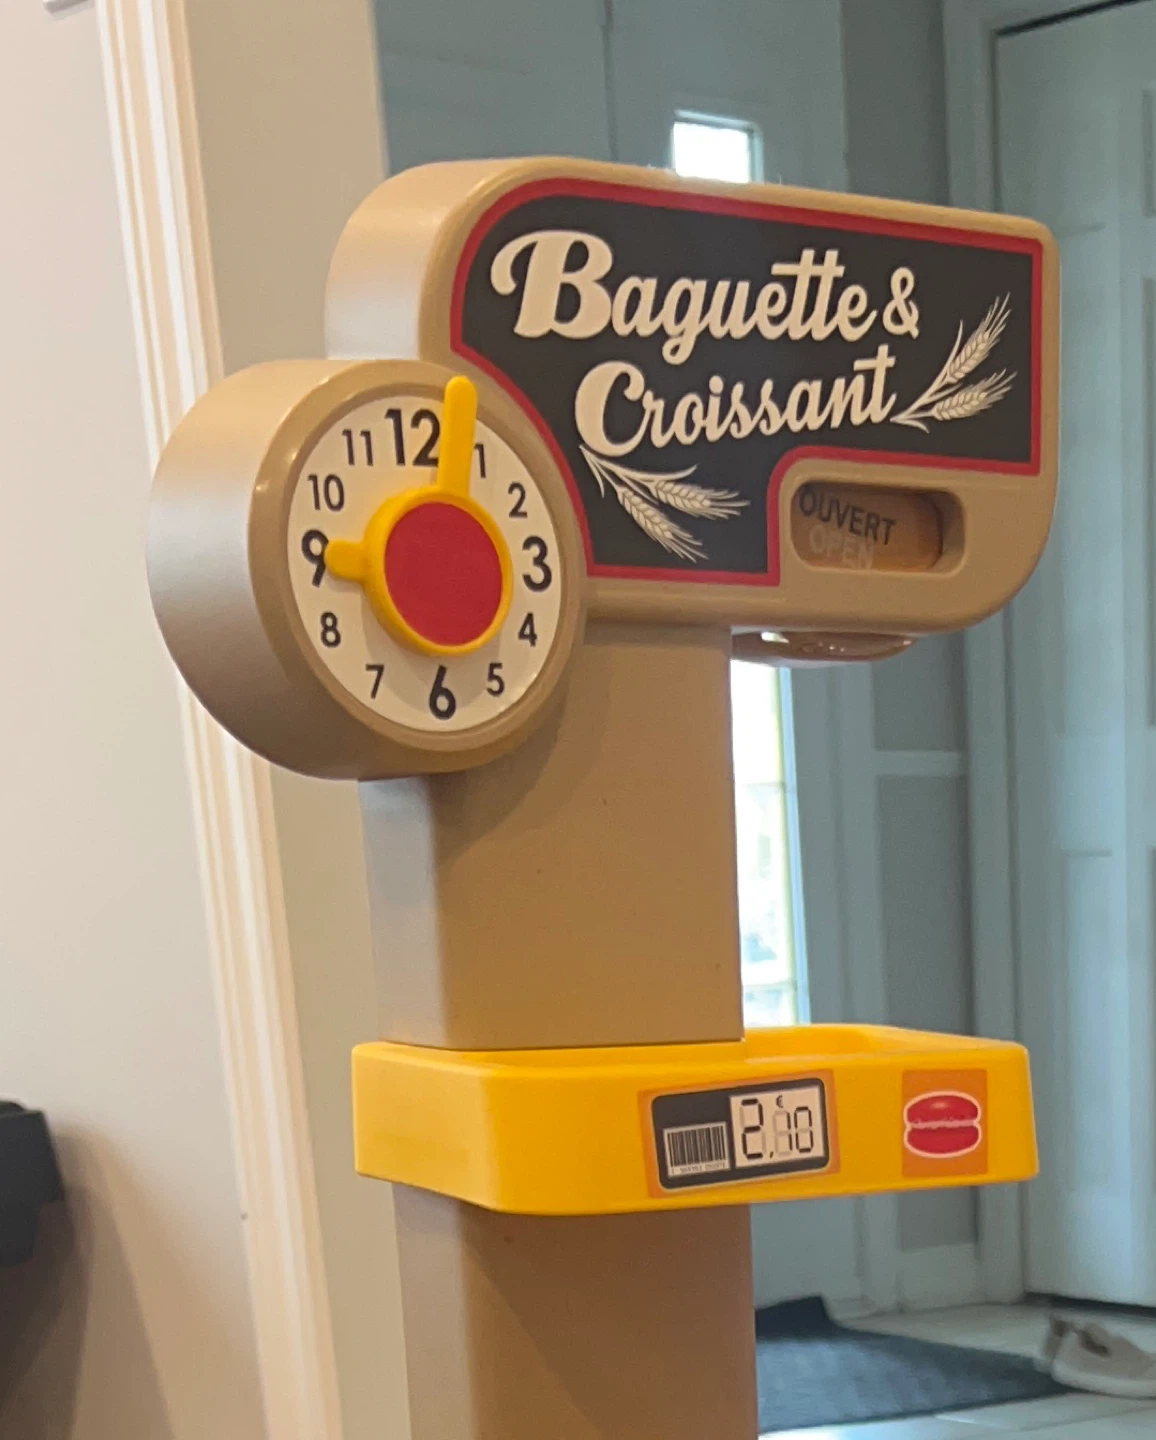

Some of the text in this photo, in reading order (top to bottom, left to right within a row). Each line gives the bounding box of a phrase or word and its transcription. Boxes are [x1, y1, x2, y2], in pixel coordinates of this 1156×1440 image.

[490, 229, 920, 365] Baguette &
[574, 344, 897, 458] Croissant
[342, 429, 374, 467] 11
[384, 408, 440, 467] 12
[473, 443, 487, 478] 1
[307, 474, 345, 512] 10
[507, 482, 528, 518] 2
[799, 489, 897, 546] OUVERT
[301, 529, 329, 588] 9
[521, 536, 553, 592] 3
[320, 611, 342, 648] 8
[517, 612, 538, 647] 4
[365, 663, 385, 700] 7
[428, 664, 456, 721] 6
[486, 662, 505, 697] 5
